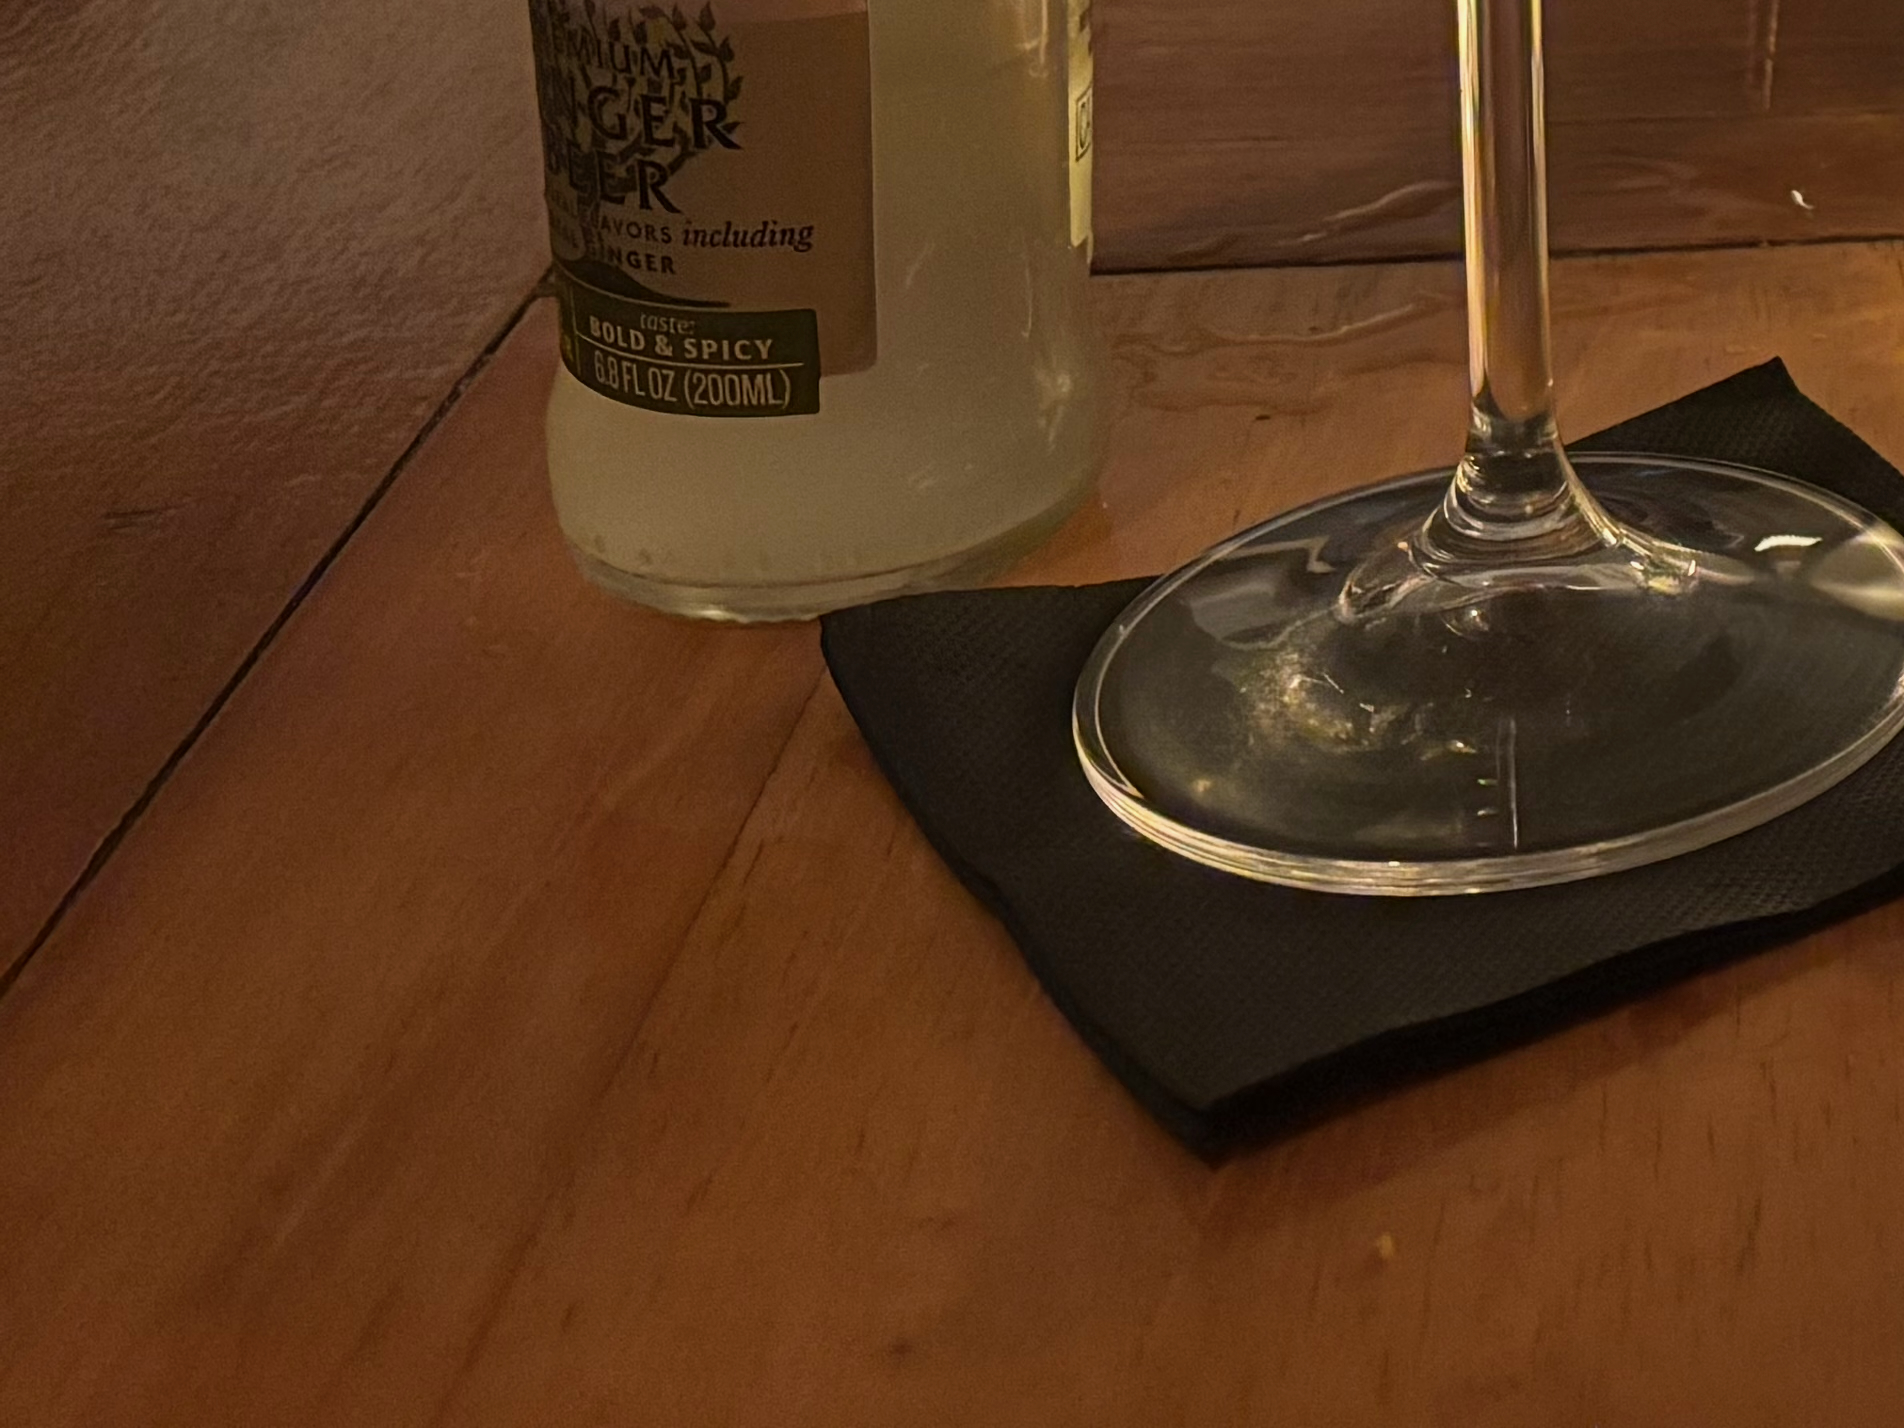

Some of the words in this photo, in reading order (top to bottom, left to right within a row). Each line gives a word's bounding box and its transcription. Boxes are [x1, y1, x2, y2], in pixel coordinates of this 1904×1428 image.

[682, 219, 814, 252] including
[589, 315, 645, 351] BOLD
[654, 335, 673, 357] &
[684, 338, 774, 361] SPICY
[622, 364, 645, 397] FL
[649, 367, 677, 402] OZ
[684, 369, 791, 409] (200ML)
